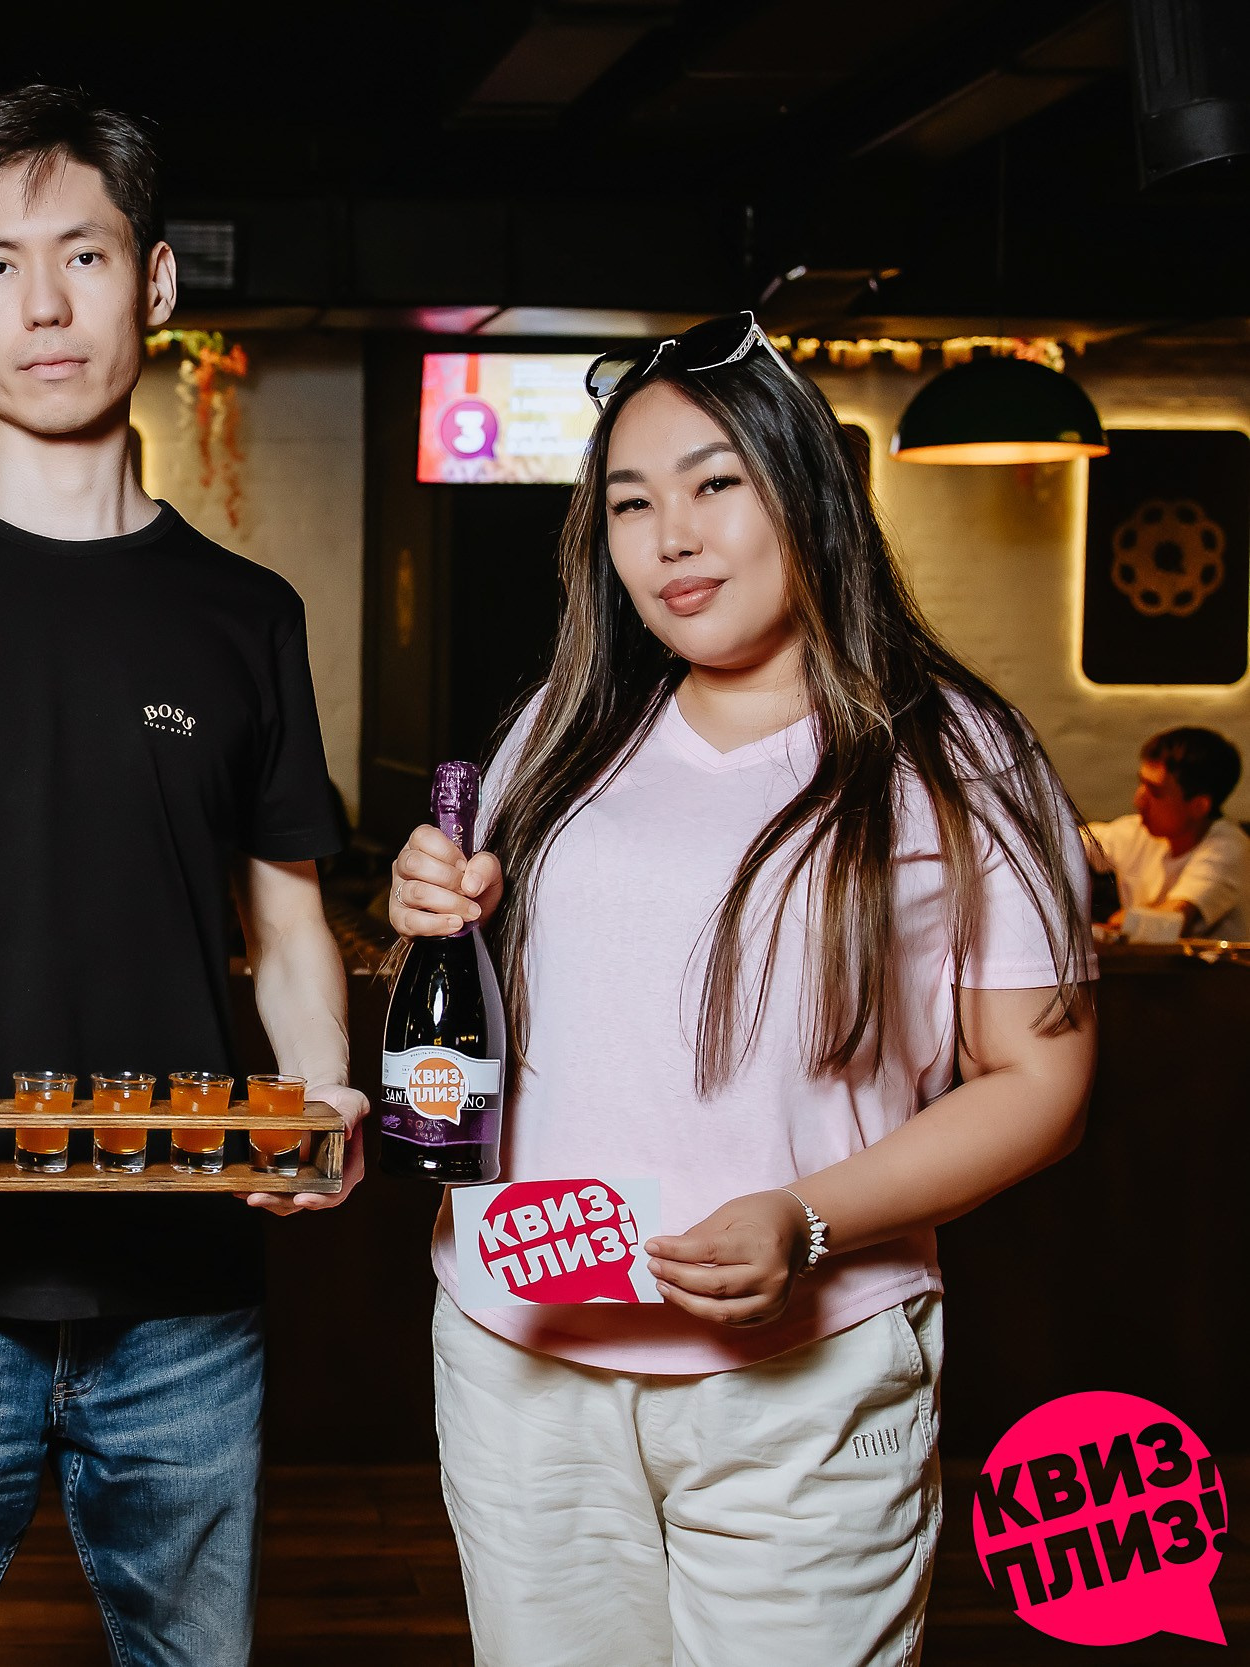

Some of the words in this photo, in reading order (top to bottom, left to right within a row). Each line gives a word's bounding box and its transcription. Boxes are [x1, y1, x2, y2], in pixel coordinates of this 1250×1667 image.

[452, 411, 487, 453] 3
[143, 704, 196, 730] BOSS
[480, 1185, 631, 1254] КВИЗ,
[487, 1221, 639, 1291] ПЛИЗ!
